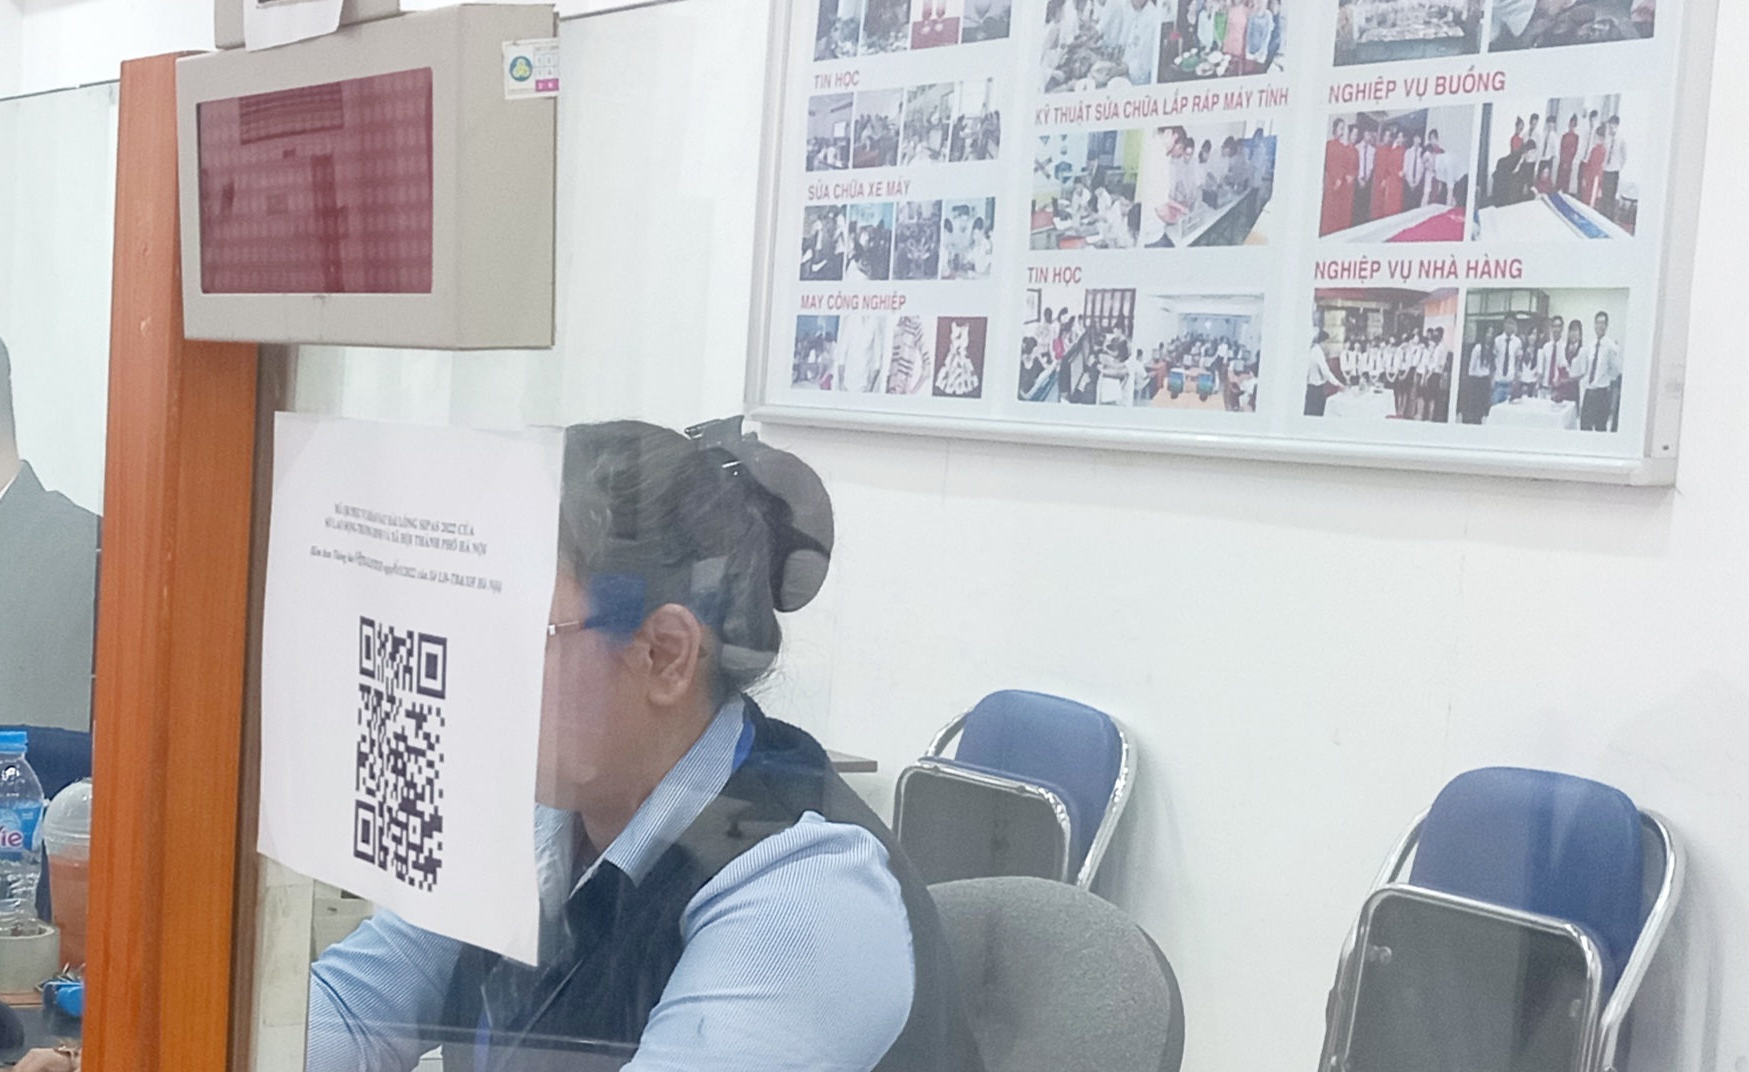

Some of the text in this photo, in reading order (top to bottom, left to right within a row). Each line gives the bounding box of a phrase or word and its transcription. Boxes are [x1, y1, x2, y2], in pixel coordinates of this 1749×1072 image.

[814, 73, 832, 89] TIN
[1328, 75, 1397, 105] NGHIỆP
[1403, 77, 1428, 102] VỤ
[1192, 88, 1220, 113] RÁP
[1223, 87, 1254, 110] MÁY
[1257, 85, 1290, 108] TÍNH
[866, 181, 883, 197] XE
[1027, 266, 1082, 287] TIN HỌC
[1314, 253, 1523, 284] NGHIỆP VỤ NHÀ HÀNG
